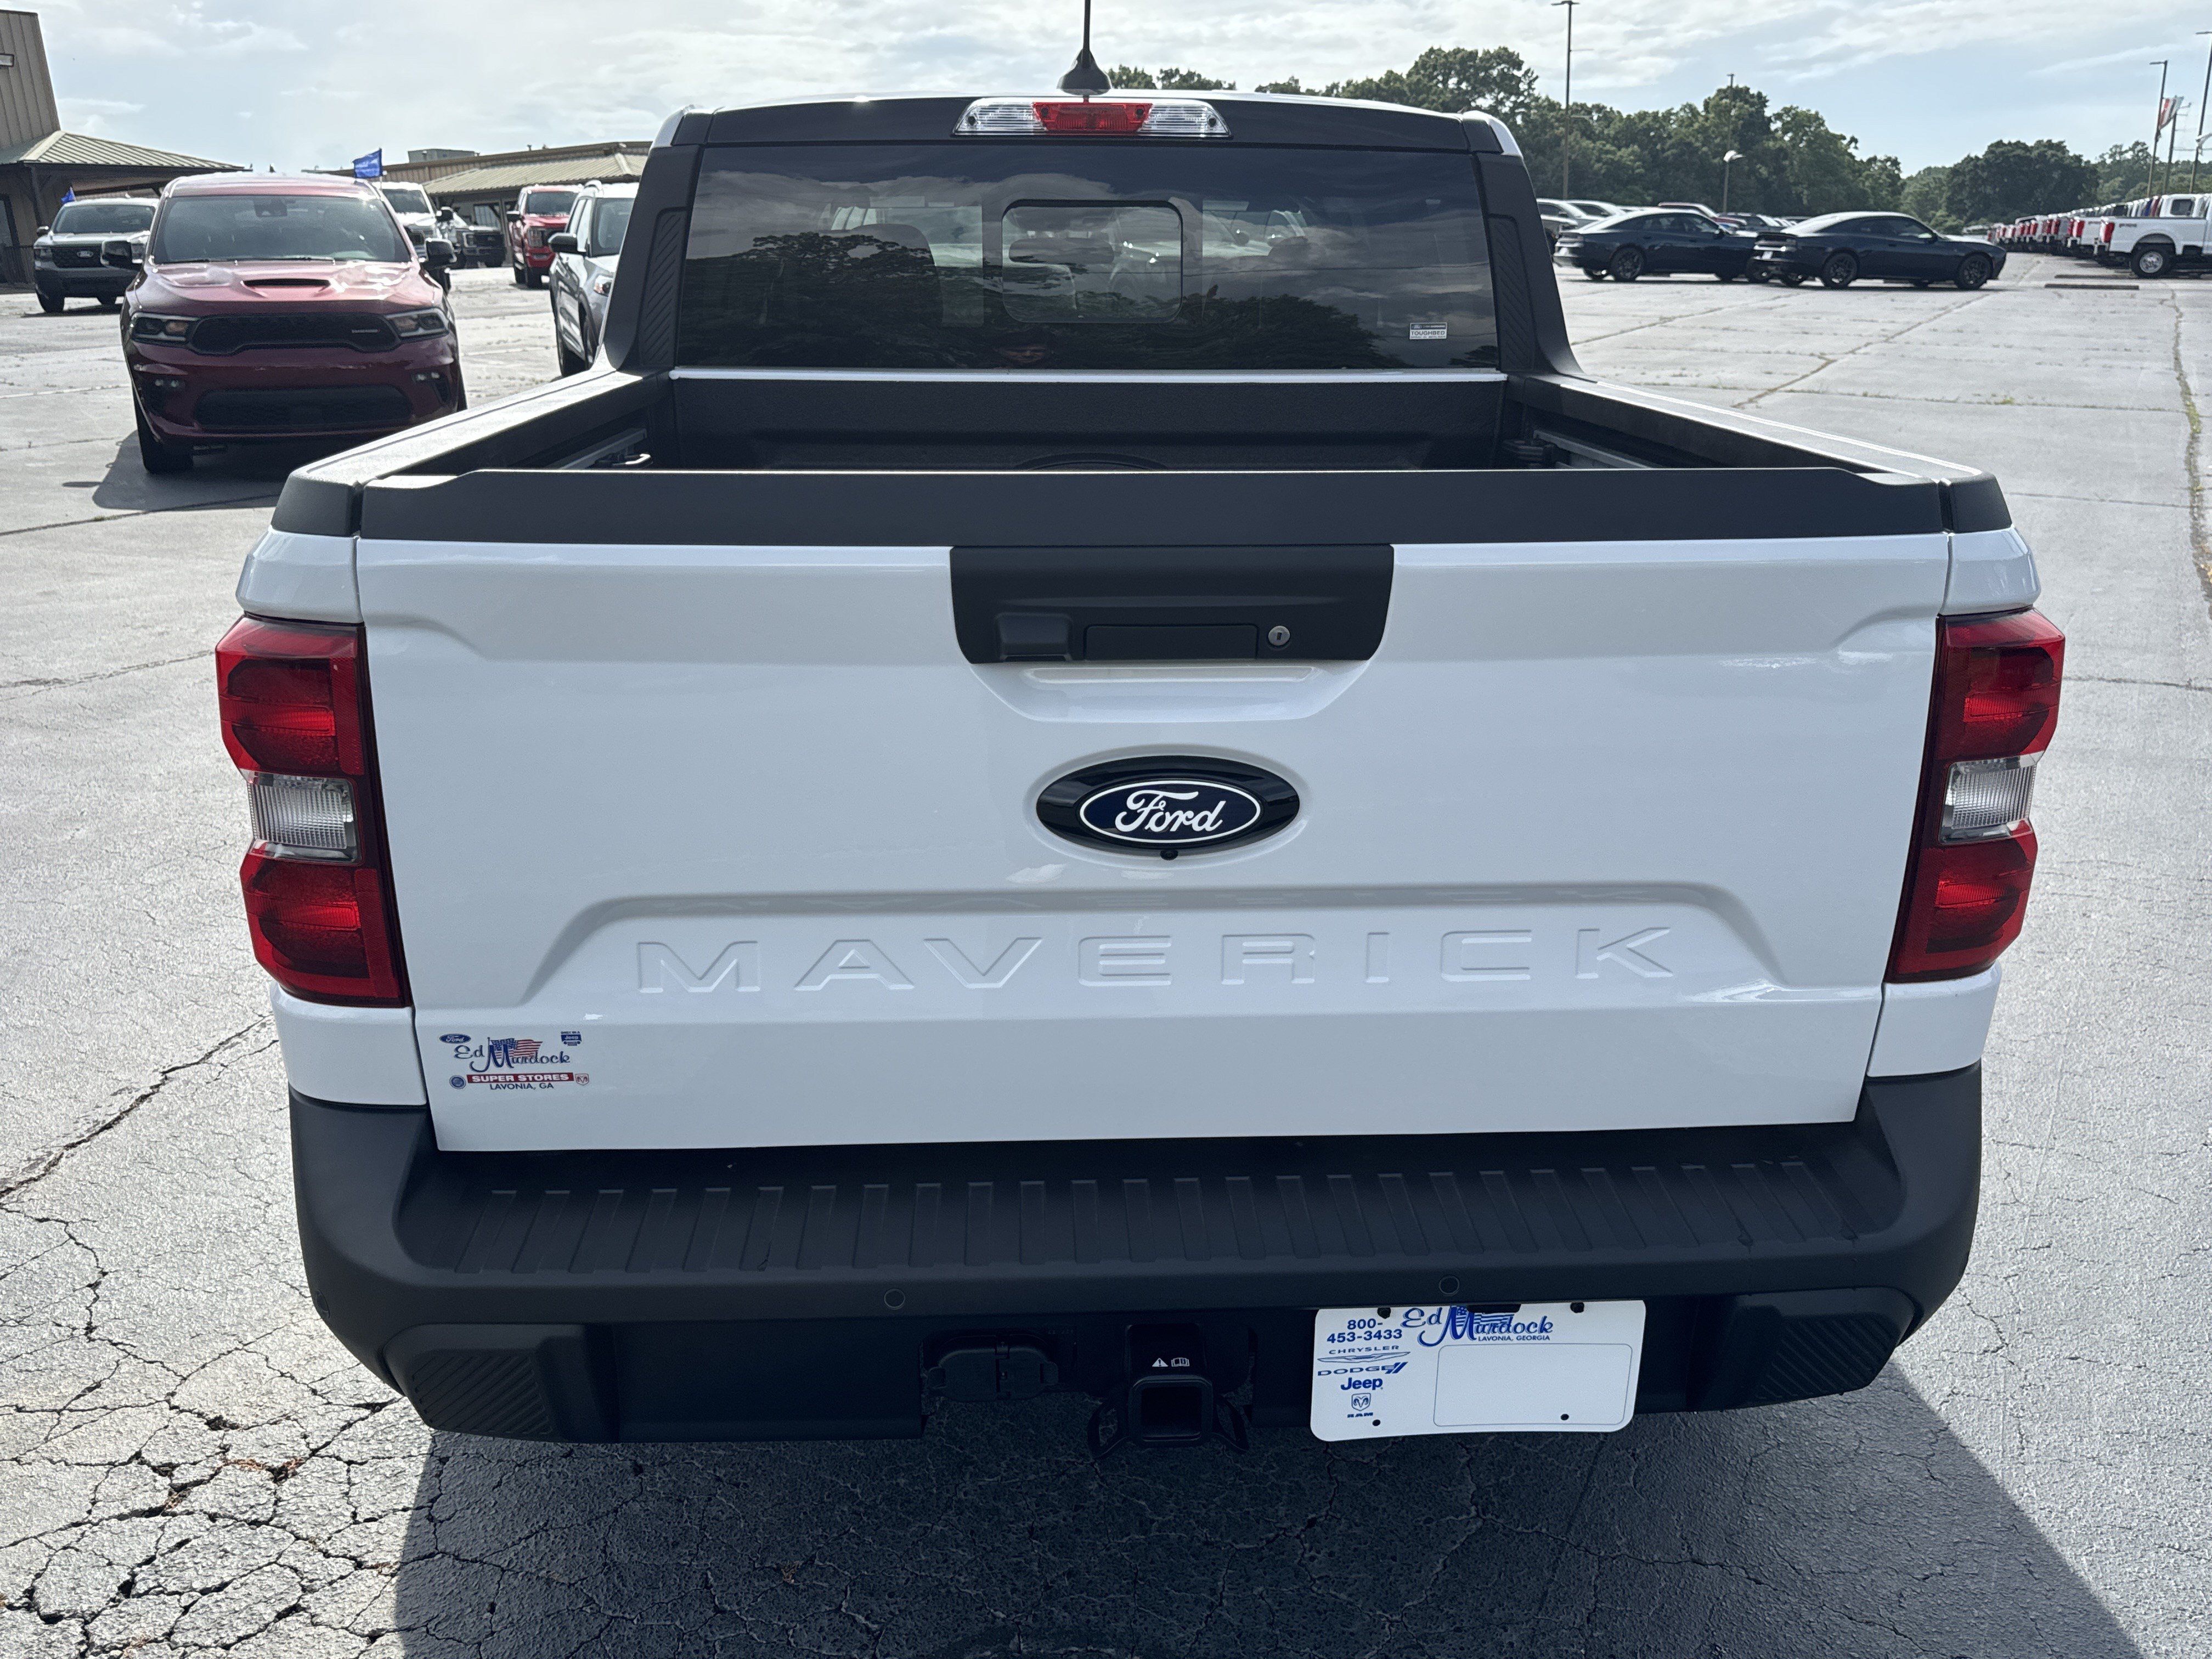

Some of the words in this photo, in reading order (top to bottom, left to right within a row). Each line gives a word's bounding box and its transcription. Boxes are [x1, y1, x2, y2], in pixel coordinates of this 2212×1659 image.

[1115, 789, 1226, 832] Ford
[637, 927, 1674, 992] MAVERICK
[454, 1045, 485, 1059] Ed
[469, 1041, 571, 1073] Murdock
[518, 1074, 569, 1082] STORES
[1347, 1318, 1383, 1330] 800-
[1400, 1307, 1442, 1328] Ed
[1417, 1305, 1554, 1347] Murdock
[1327, 1329, 1402, 1344] 453-3433
[1329, 1345, 1400, 1355] CHRYSLER
[1317, 1364, 1396, 1376] DODGE
[1340, 1377, 1383, 1390] Jeep
